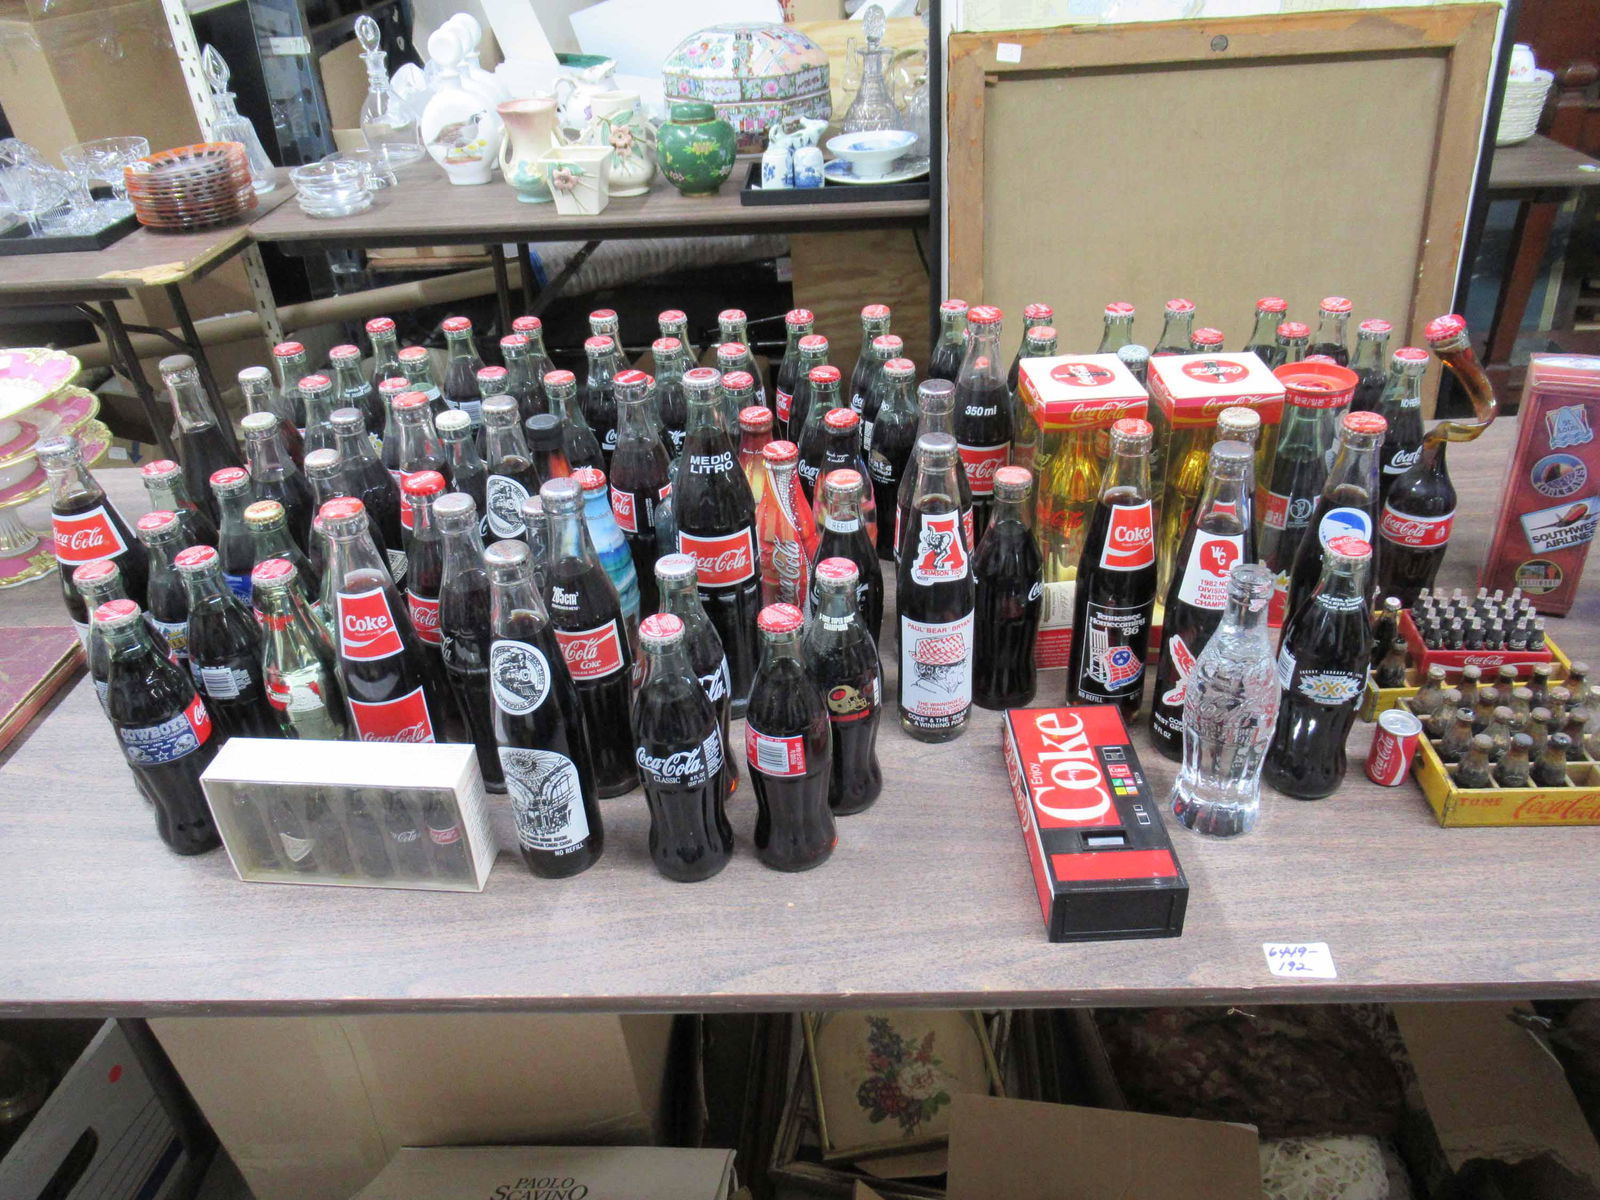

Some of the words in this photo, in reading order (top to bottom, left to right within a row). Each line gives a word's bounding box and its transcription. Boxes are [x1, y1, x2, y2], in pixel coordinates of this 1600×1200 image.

[965, 405, 984, 416] 350
[984, 405, 997, 416] ml
[1070, 401, 1128, 422] Coca-Cola
[690, 451, 732, 466] MEDIO
[690, 461, 734, 475] LITRO
[832, 521, 854, 531] REFILL
[1383, 513, 1435, 537] Coca-Cola
[1114, 526, 1151, 543] Coke
[920, 568, 949, 578] CRIMSON
[1198, 585, 1228, 593] DIVISIO
[1194, 599, 1228, 608] CHAMPI
[1199, 593, 1228, 601] NATION
[345, 614, 388, 632] Coke
[1089, 617, 1146, 629] Homecoming
[1095, 611, 1142, 623] Tennessee
[1464, 655, 1505, 666] Coca-Cola
[1086, 692, 1103, 704] REFILL
[120, 714, 189, 740] COWBOYS
[635, 746, 704, 777] Coca-Cola
[1371, 733, 1394, 780] Coca-Cola
[1030, 762, 1043, 785] Enjoy
[1034, 713, 1111, 821] Coke
[653, 774, 681, 784] CLASSIC
[555, 849, 564, 857] NO
[566, 842, 584, 854] REFILL
[513, 1177, 575, 1189] PAOLO
